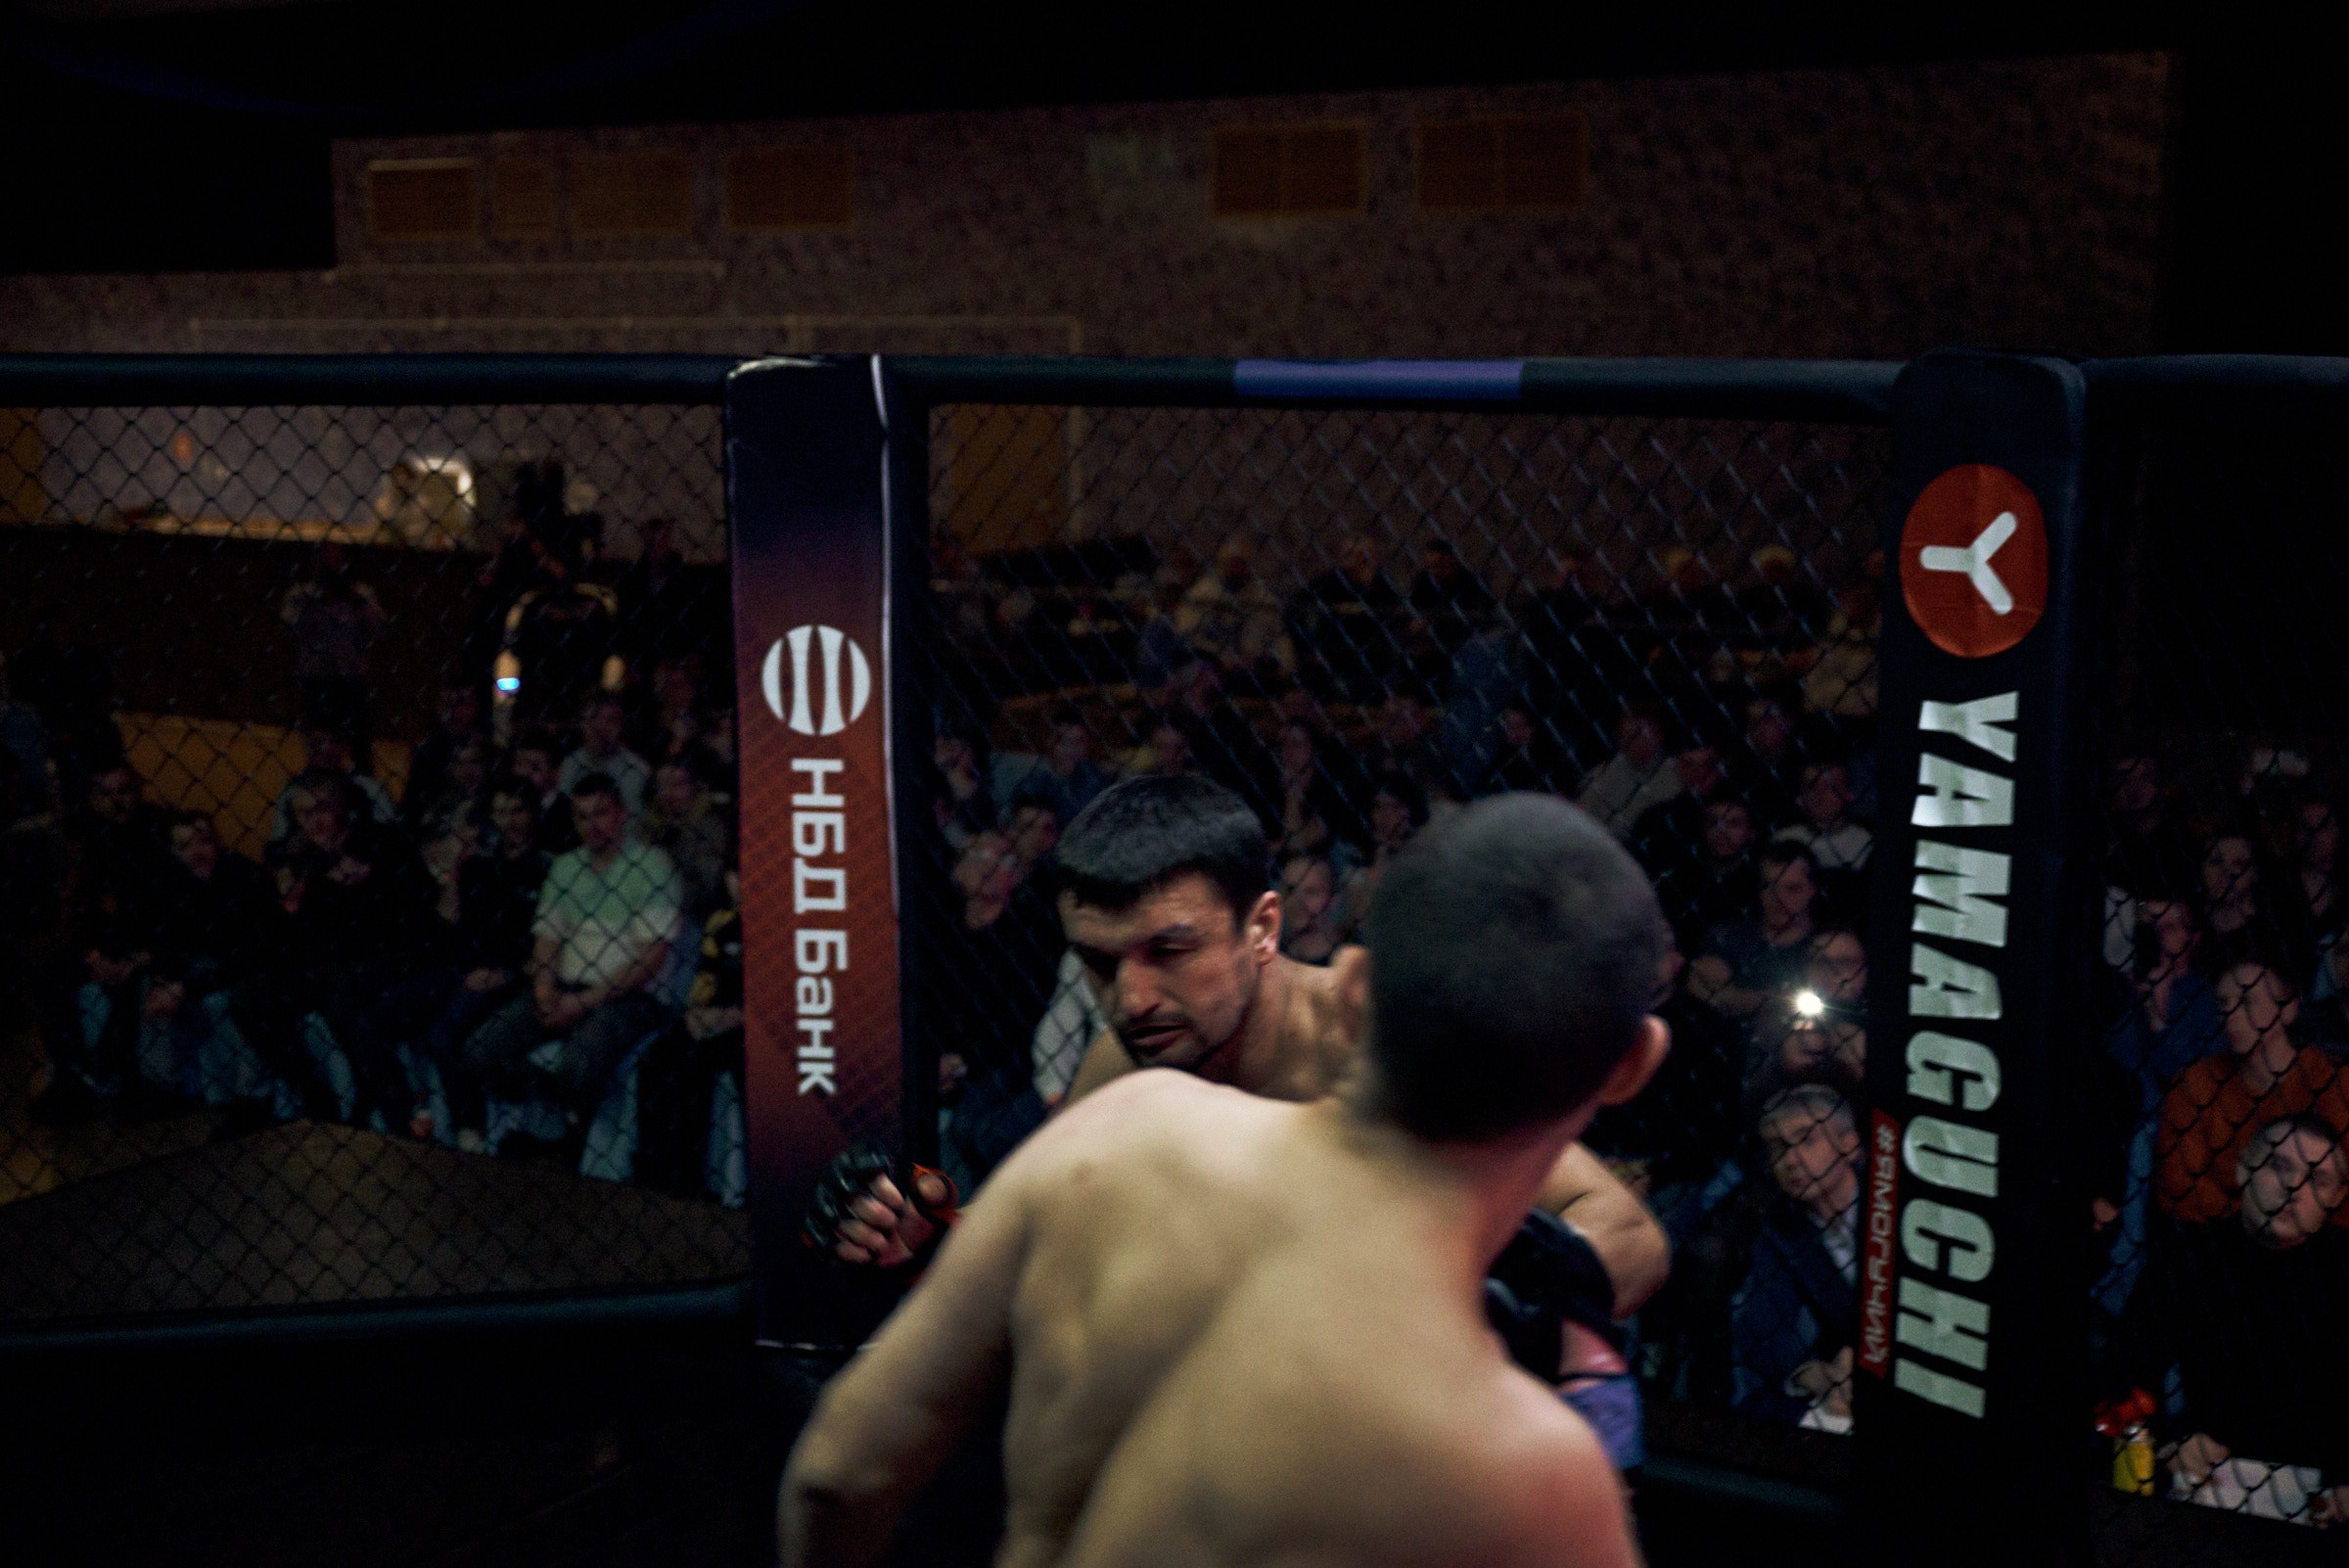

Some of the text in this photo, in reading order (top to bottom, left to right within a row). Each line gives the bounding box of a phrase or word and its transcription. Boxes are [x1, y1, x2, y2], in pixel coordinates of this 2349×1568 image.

[790, 758, 849, 1096] НБД Банк
[1894, 690, 2020, 1419] YAMAGUCHI
[1864, 1124, 1897, 1363] #ЯМОГУЧИЙ
